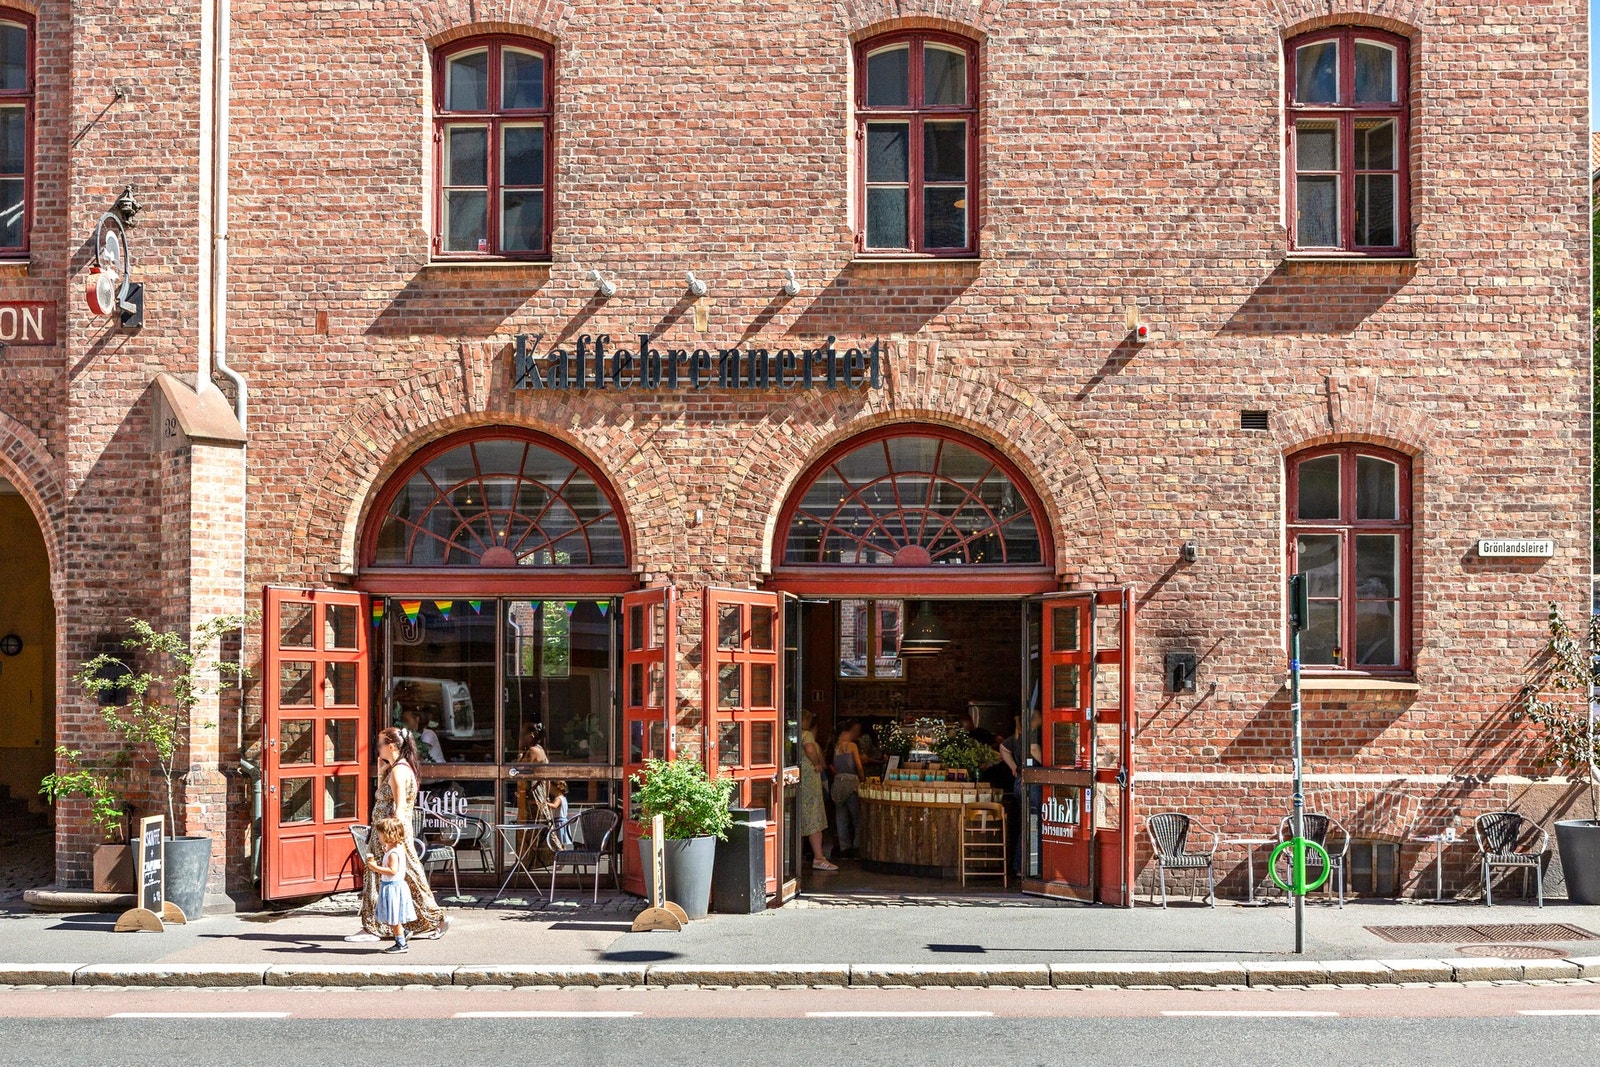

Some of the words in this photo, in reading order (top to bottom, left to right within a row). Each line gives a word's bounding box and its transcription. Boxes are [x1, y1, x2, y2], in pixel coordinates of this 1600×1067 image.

[0, 307, 44, 340] ON
[514, 333, 884, 390] Kaffebrenneriet
[164, 417, 177, 438] 32
[1483, 542, 1549, 553] Grönlandsleiret
[419, 790, 468, 815] Kaffe
[422, 816, 467, 828] renneriet
